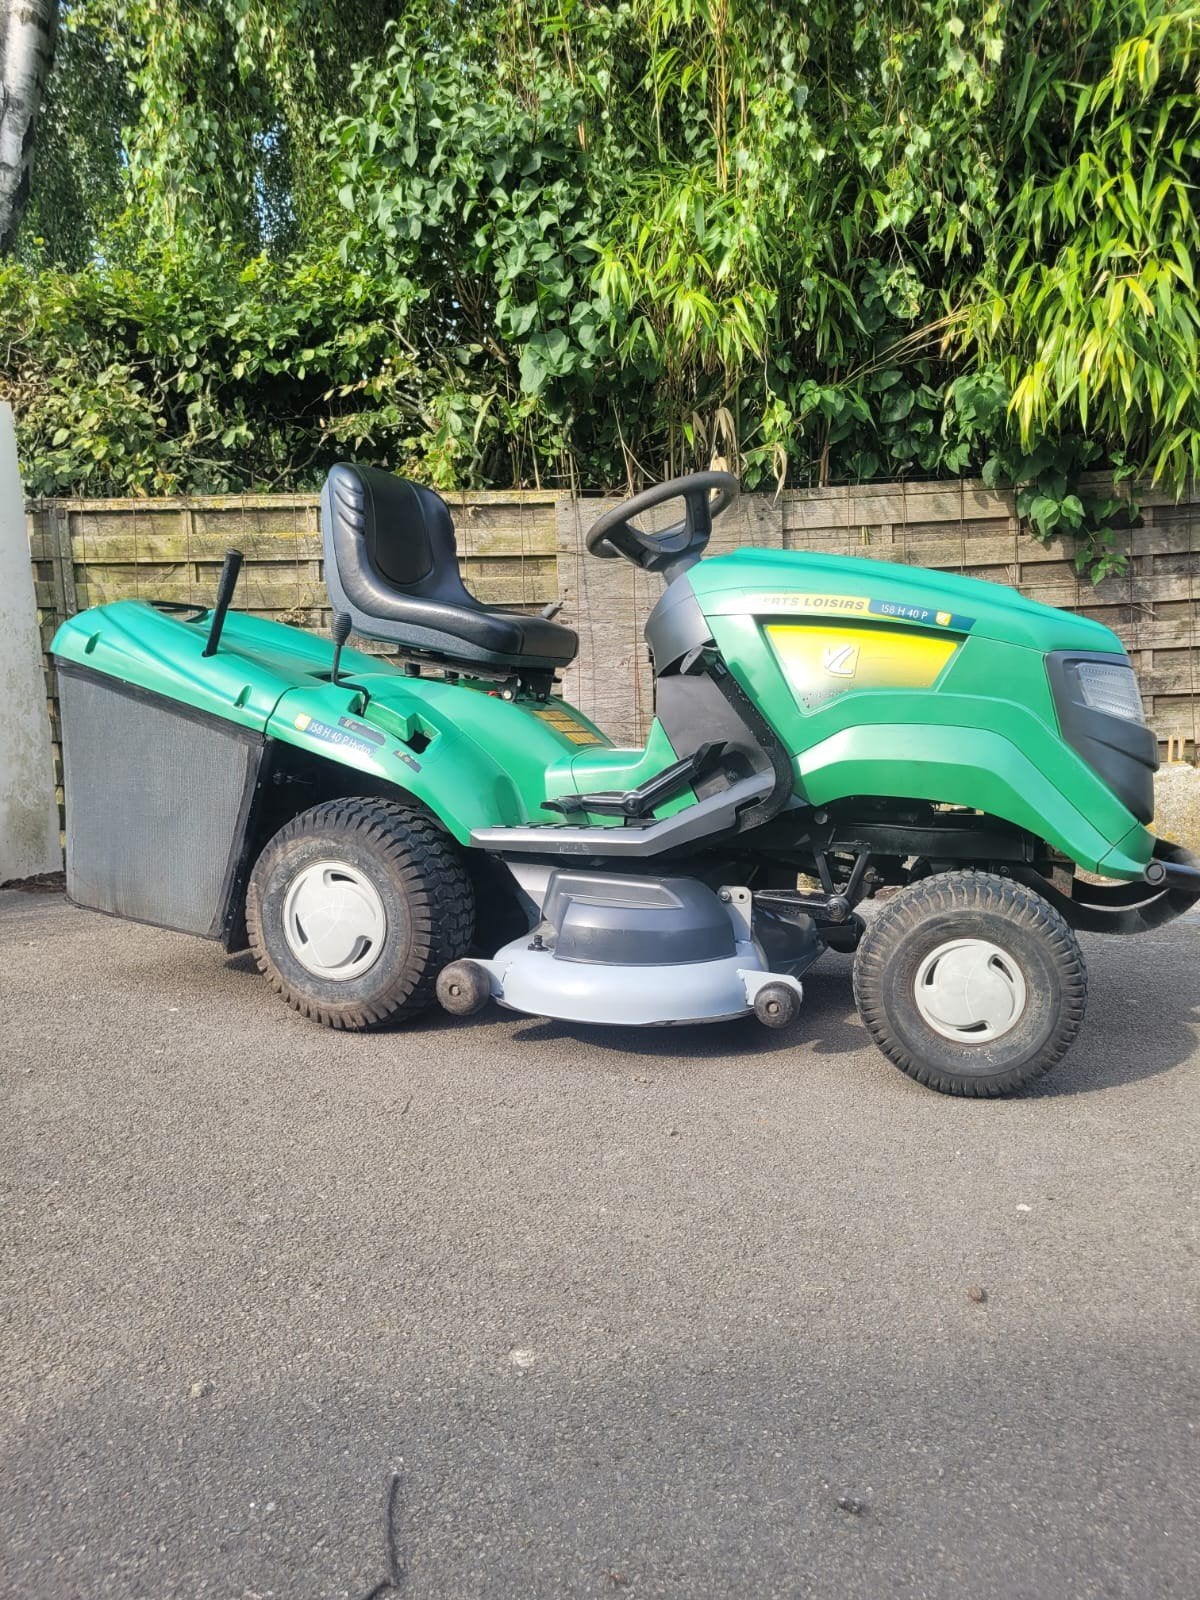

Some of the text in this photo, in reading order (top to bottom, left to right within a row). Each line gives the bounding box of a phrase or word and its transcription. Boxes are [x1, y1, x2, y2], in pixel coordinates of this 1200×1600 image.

[804, 598, 864, 610] LOISIRS
[881, 603, 929, 620] 158 H 40 P
[311, 722, 323, 734] 158
[323, 727, 332, 737] H
[331, 731, 342, 743] 40
[342, 735, 349, 745] P
